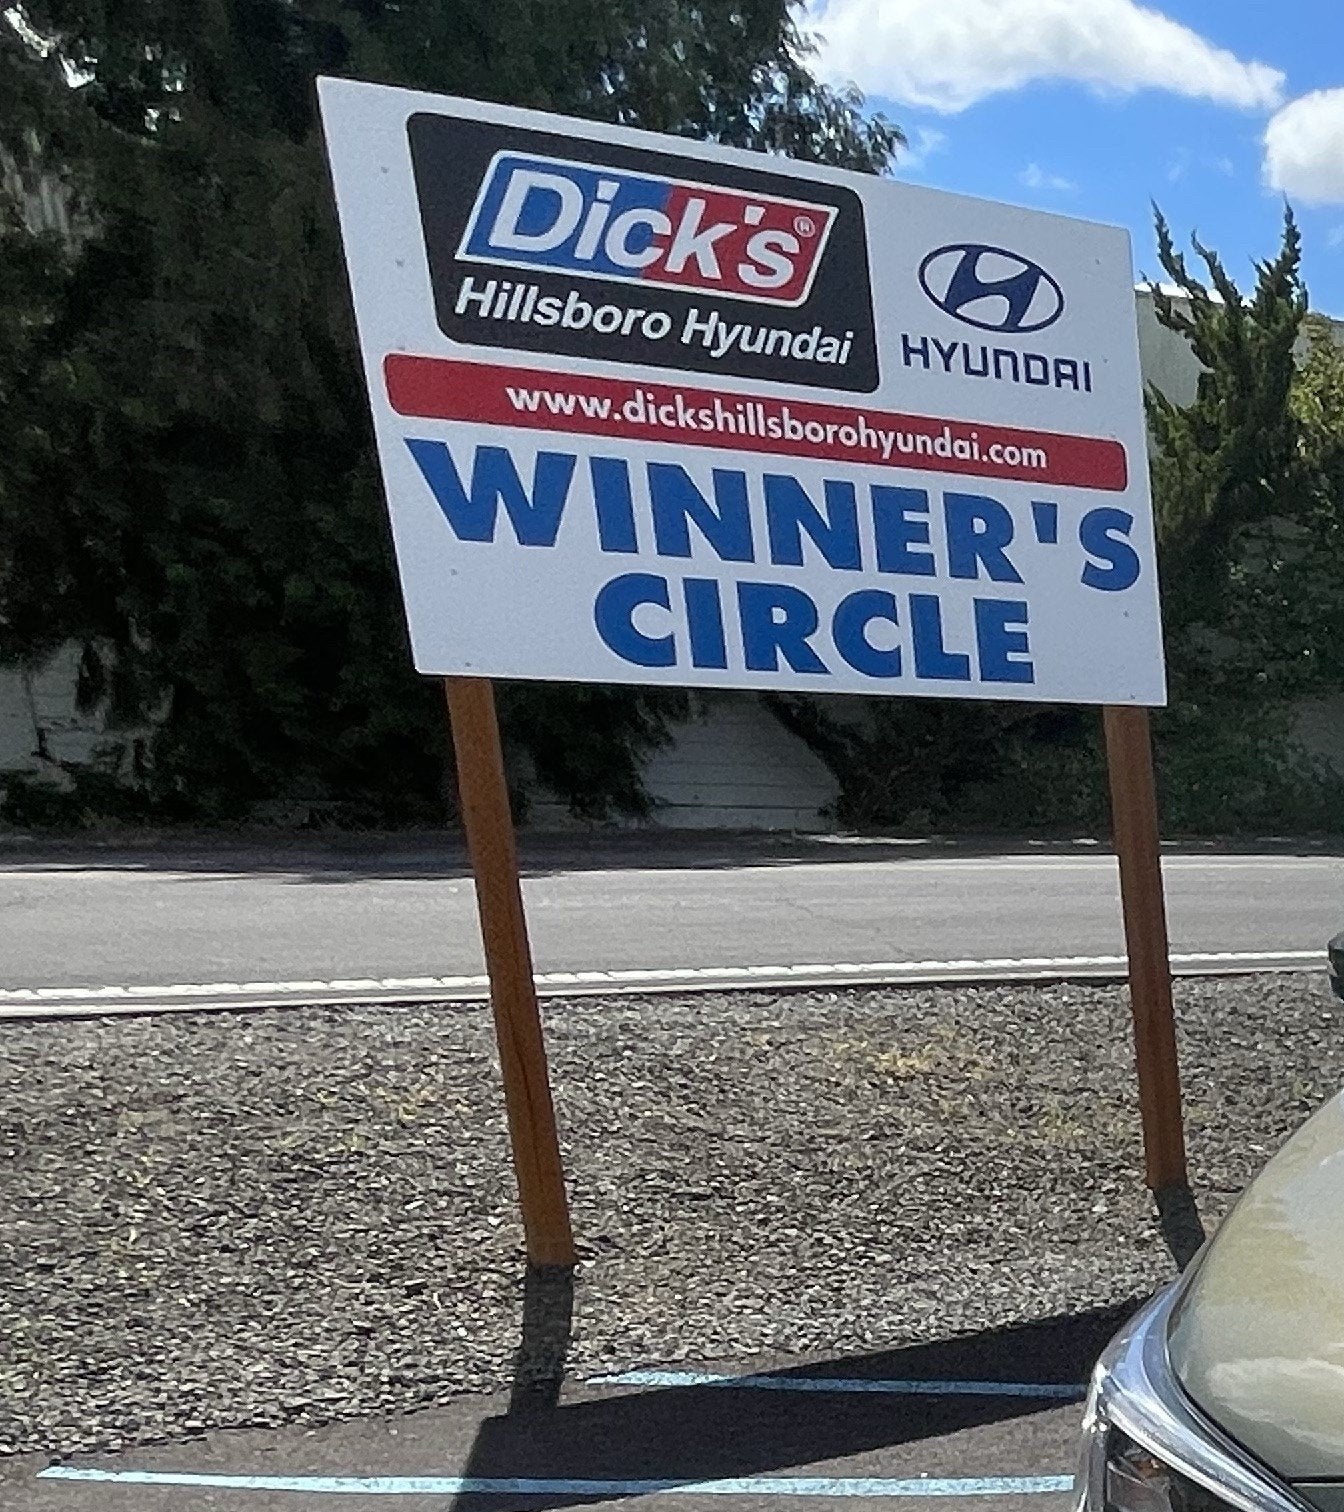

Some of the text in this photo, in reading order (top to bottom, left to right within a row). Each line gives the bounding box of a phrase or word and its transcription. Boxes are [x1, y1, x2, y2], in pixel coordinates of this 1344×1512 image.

[487, 168, 801, 289] Dick's
[454, 276, 854, 364] Hillsboro Hyundai
[902, 333, 1092, 393] HYUNDAI
[505, 384, 1047, 469] www.dickshillsborohyundai.com
[403, 438, 1141, 591] WINNER'S
[594, 572, 1035, 684] CIRCLE
